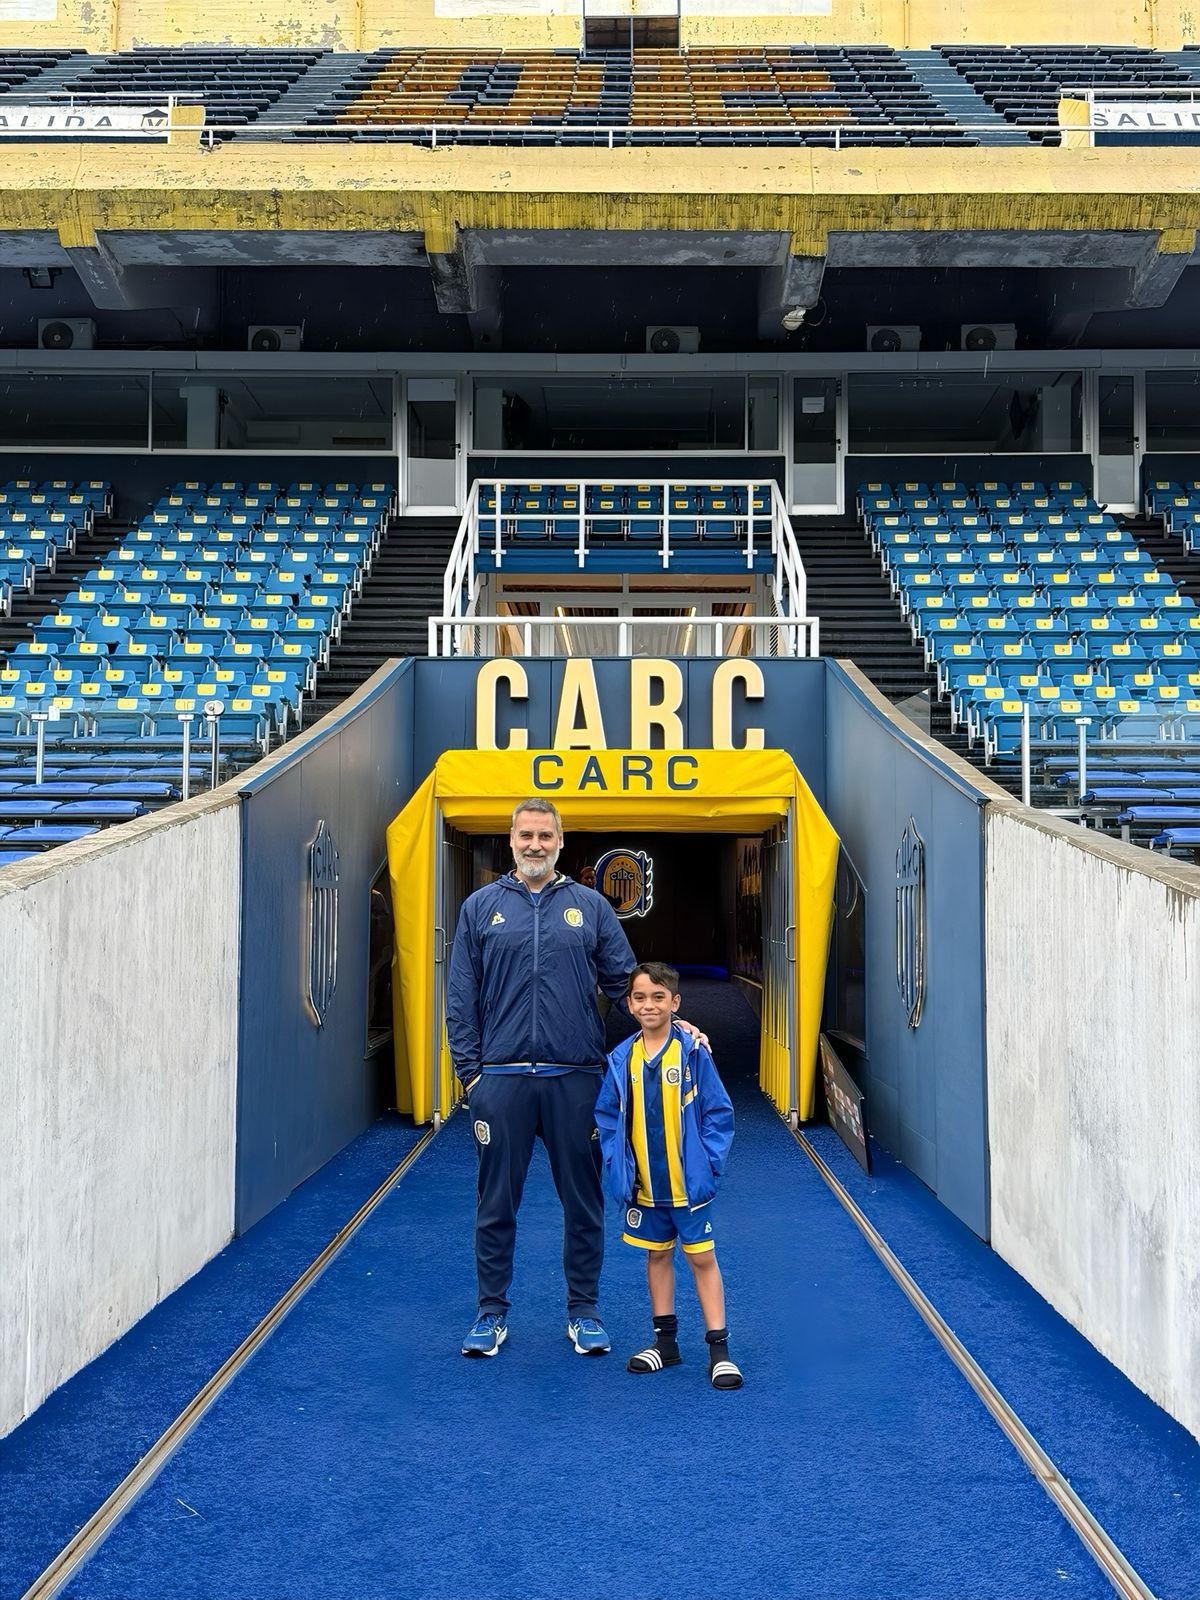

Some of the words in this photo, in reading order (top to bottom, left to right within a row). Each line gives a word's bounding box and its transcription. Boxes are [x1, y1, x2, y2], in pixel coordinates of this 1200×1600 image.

[476, 658, 765, 750] CARC
[531, 754, 699, 791] CARC
[611, 870, 634, 880] CARC
